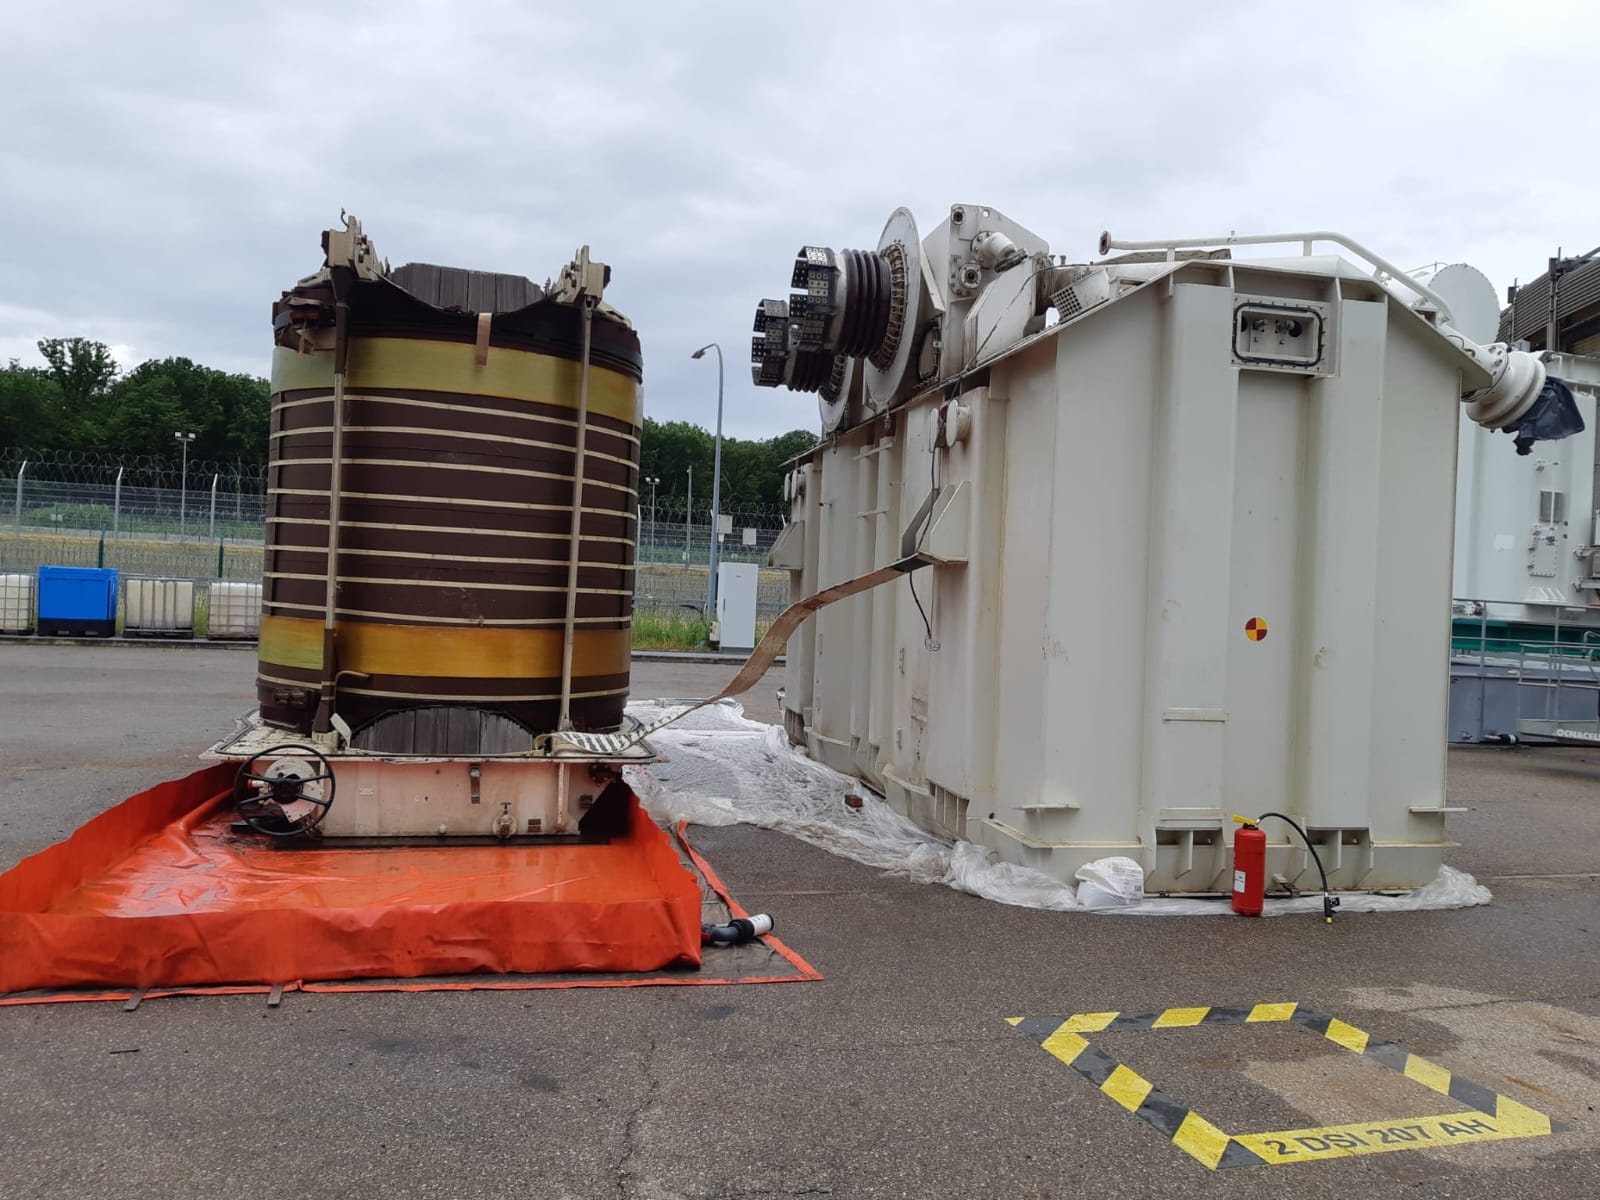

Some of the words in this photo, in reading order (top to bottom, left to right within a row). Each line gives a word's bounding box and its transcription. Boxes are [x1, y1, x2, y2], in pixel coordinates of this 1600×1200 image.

[1264, 1140, 1298, 1155] 2
[1293, 1132, 1370, 1151] DSI
[1366, 1125, 1432, 1143] 207
[1438, 1119, 1499, 1136] AH
